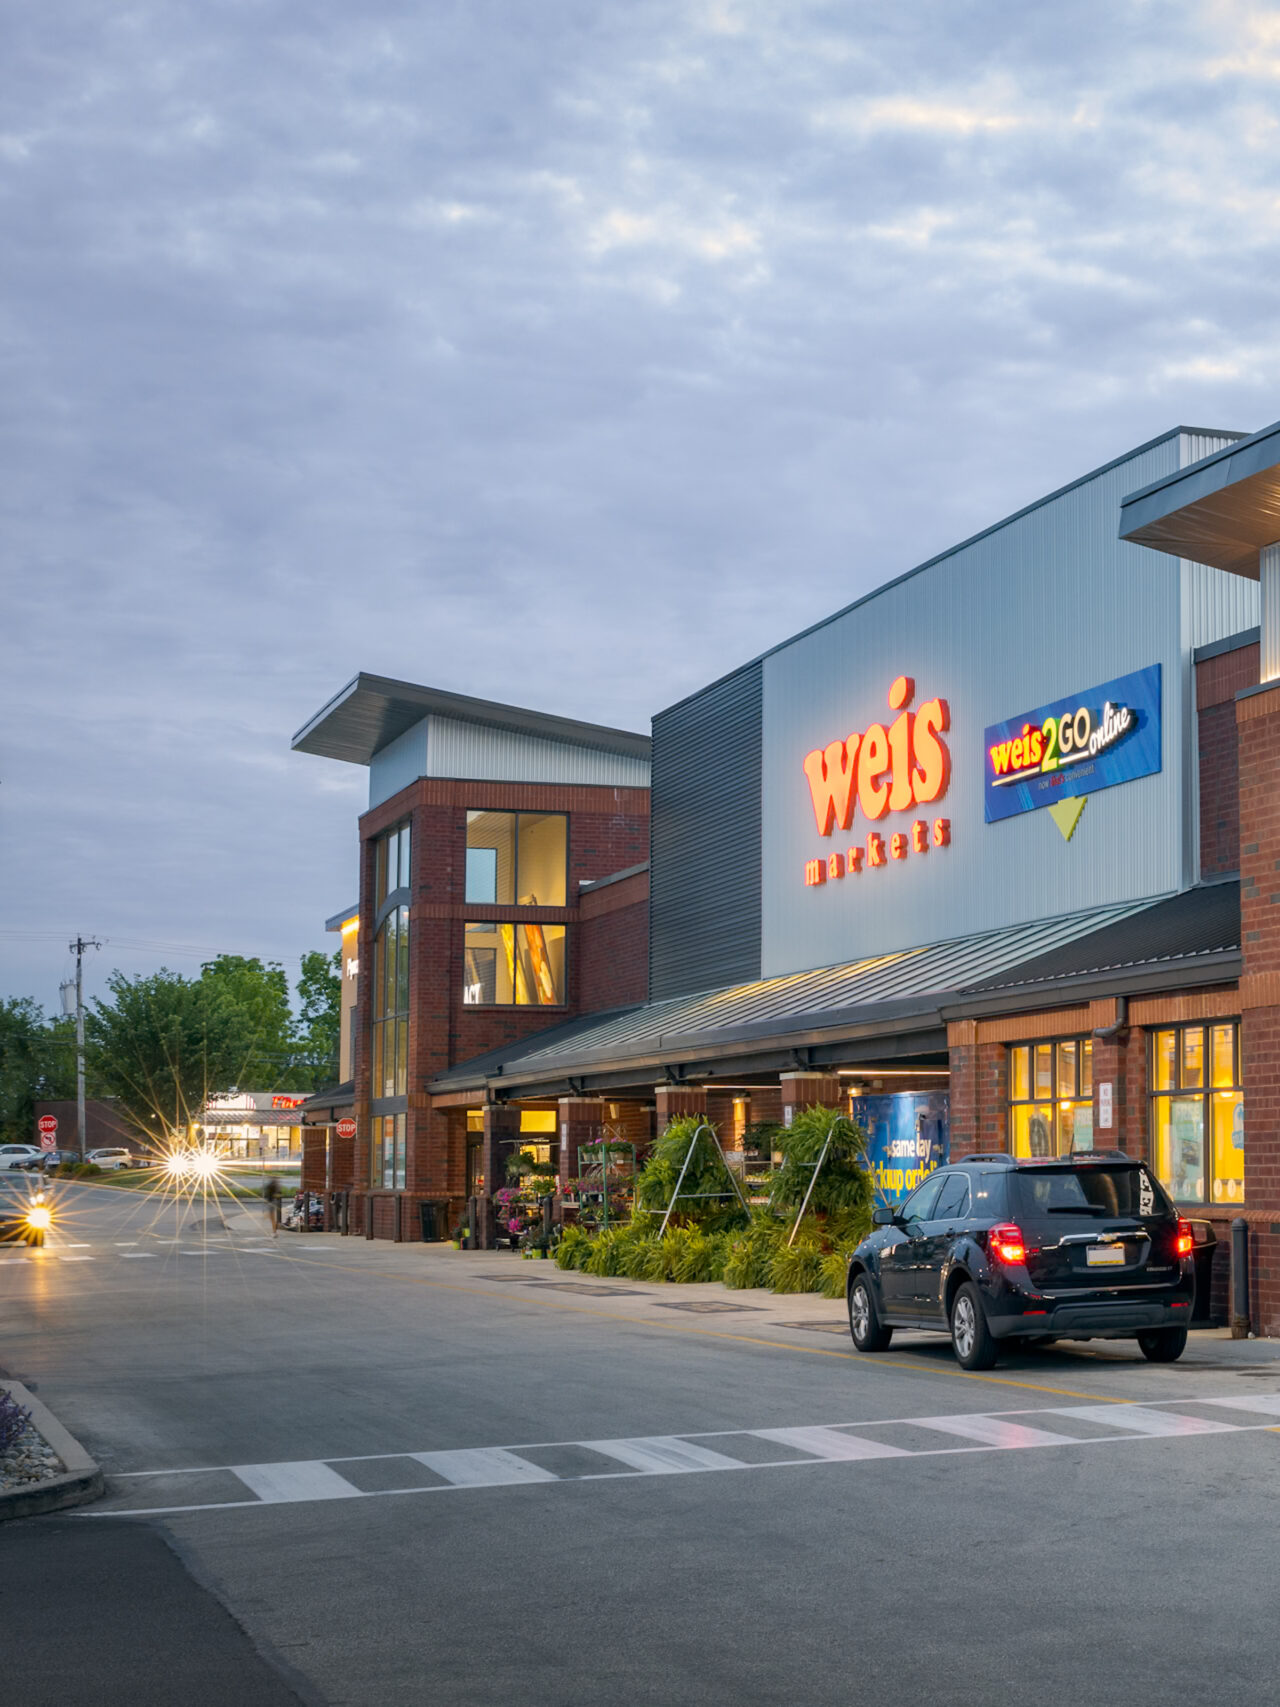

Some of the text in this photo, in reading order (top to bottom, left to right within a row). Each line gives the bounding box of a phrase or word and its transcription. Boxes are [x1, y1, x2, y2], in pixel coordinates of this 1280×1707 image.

[1089, 701, 1131, 755] online
[803, 676, 949, 837] weis
[804, 818, 951, 886] markets
[40, 1121, 56, 1129] STOP
[338, 1123, 355, 1133] STOP
[891, 1139, 915, 1158] same
[869, 1160, 903, 1197] ickup
